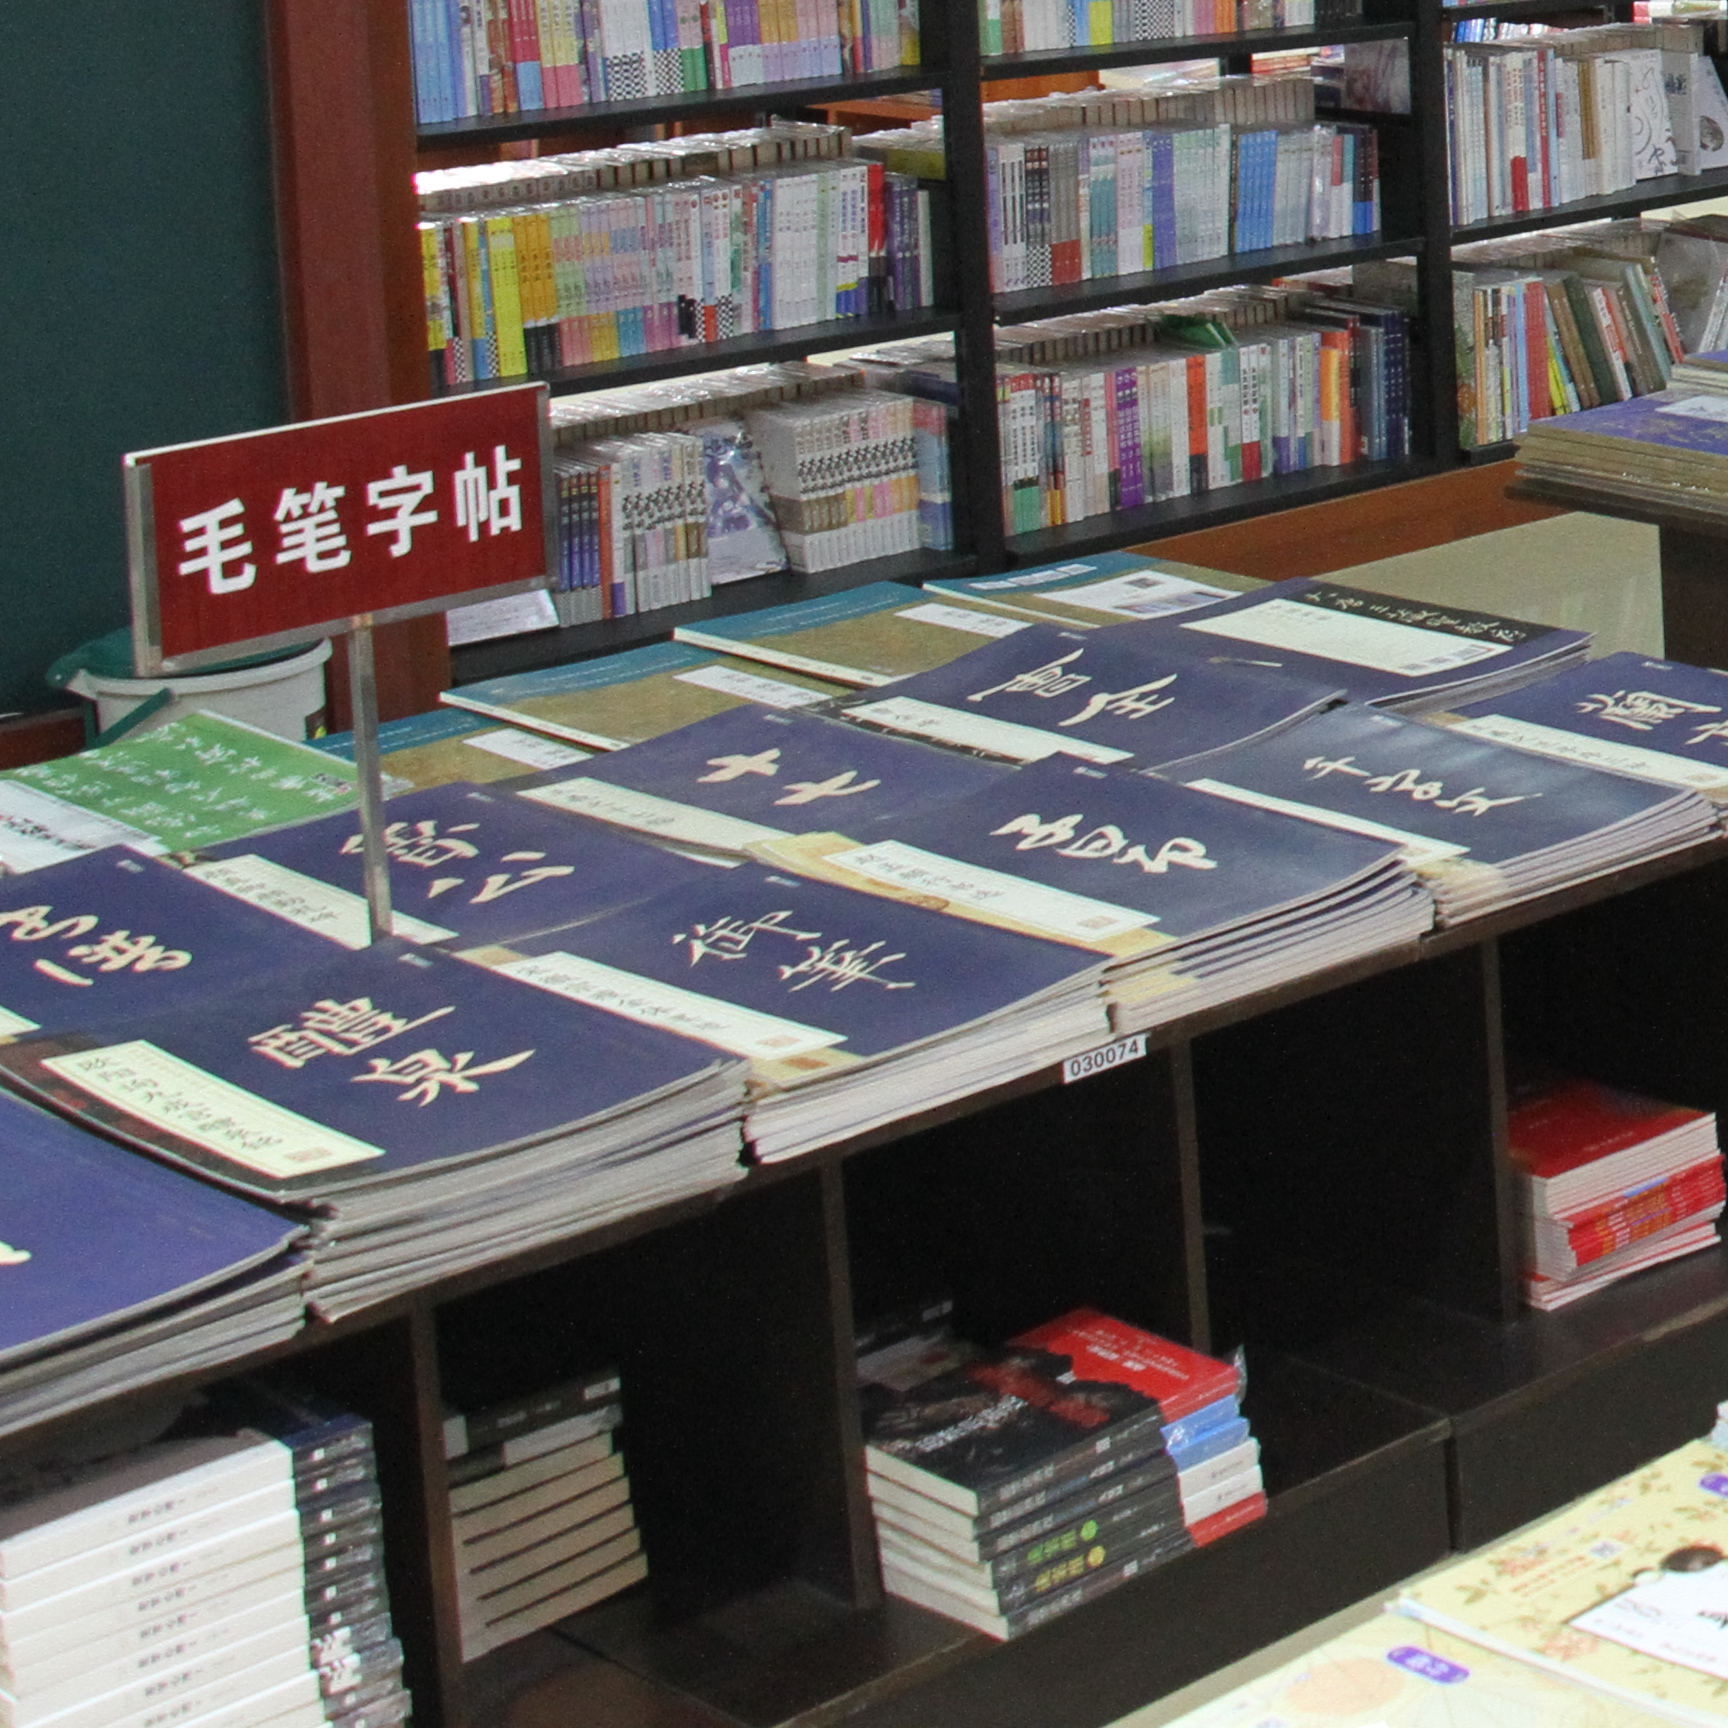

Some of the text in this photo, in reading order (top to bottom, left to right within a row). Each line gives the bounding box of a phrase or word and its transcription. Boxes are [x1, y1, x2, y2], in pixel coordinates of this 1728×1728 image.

[177, 444, 523, 596] 毛笔字帖
[249, 995, 539, 1109] 醴泉
[1068, 1038, 1142, 1080] 030074
